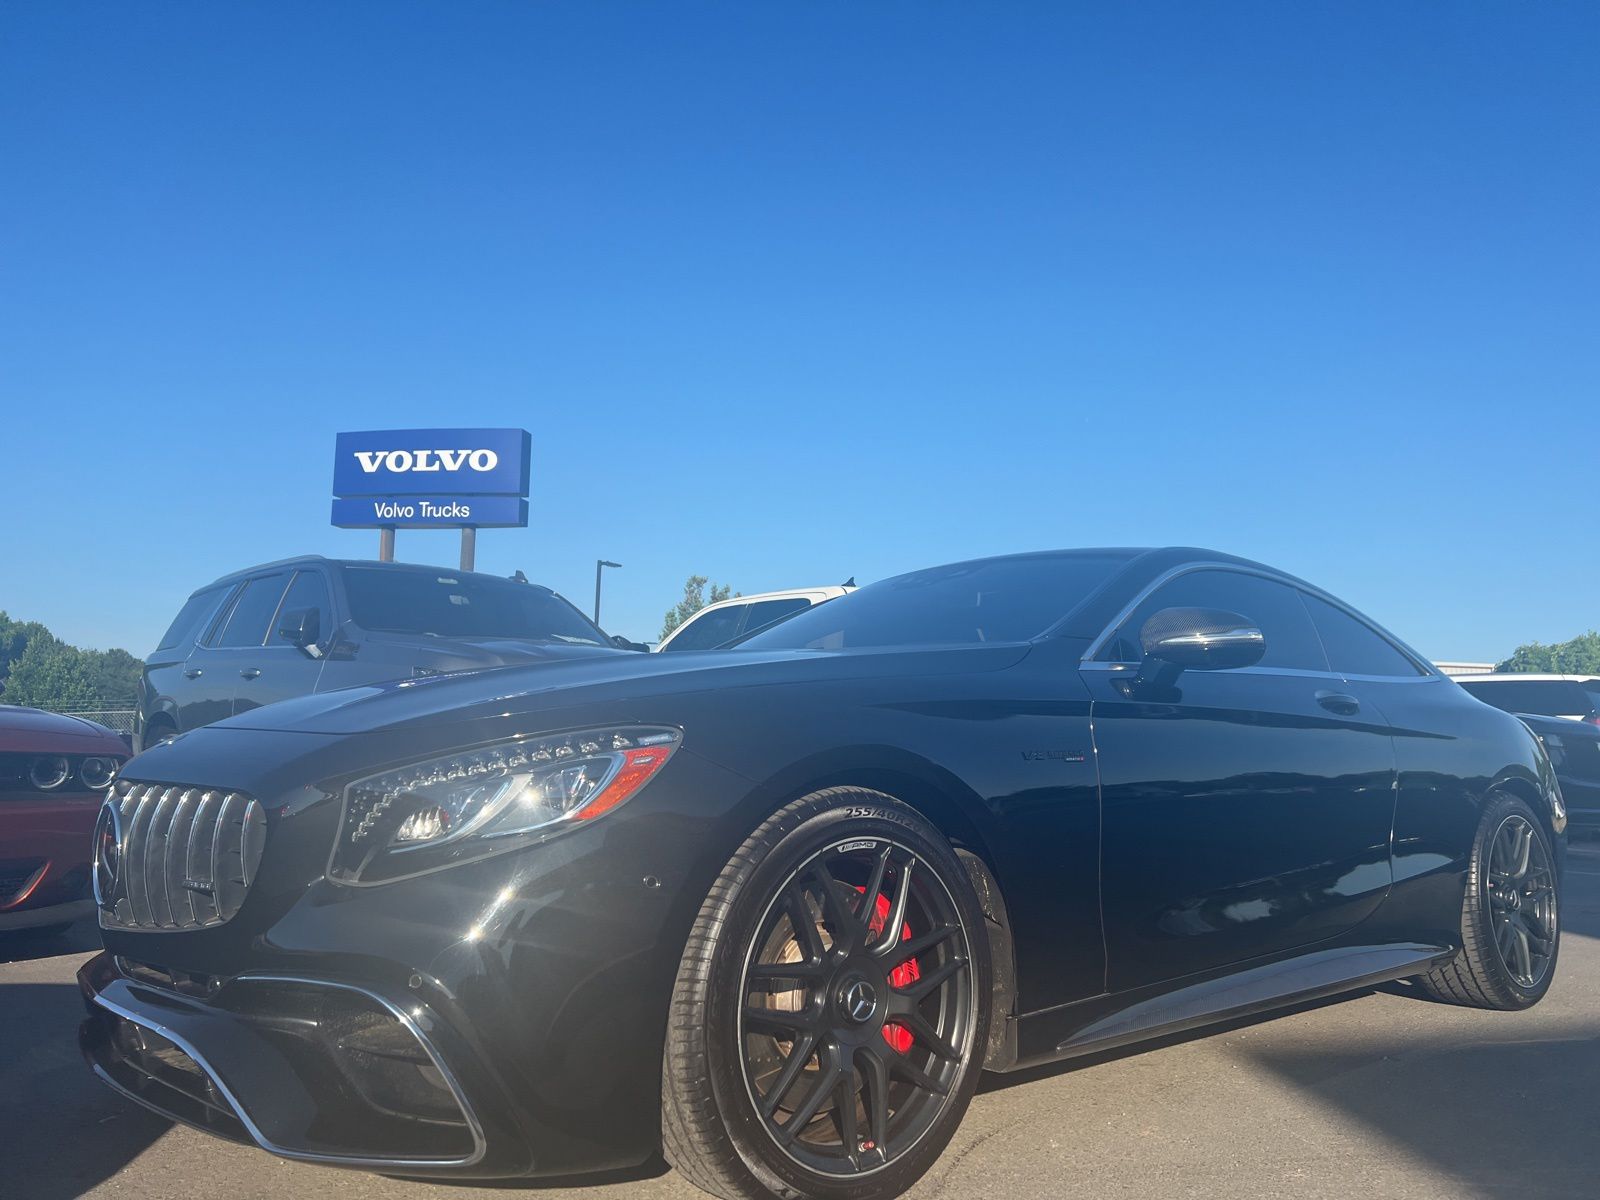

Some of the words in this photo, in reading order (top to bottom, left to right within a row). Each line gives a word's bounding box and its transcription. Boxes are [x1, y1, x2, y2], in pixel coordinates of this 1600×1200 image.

[354, 449, 498, 473] VOLVO
[374, 502, 414, 518] Volvo
[418, 501, 470, 518] Trucks
